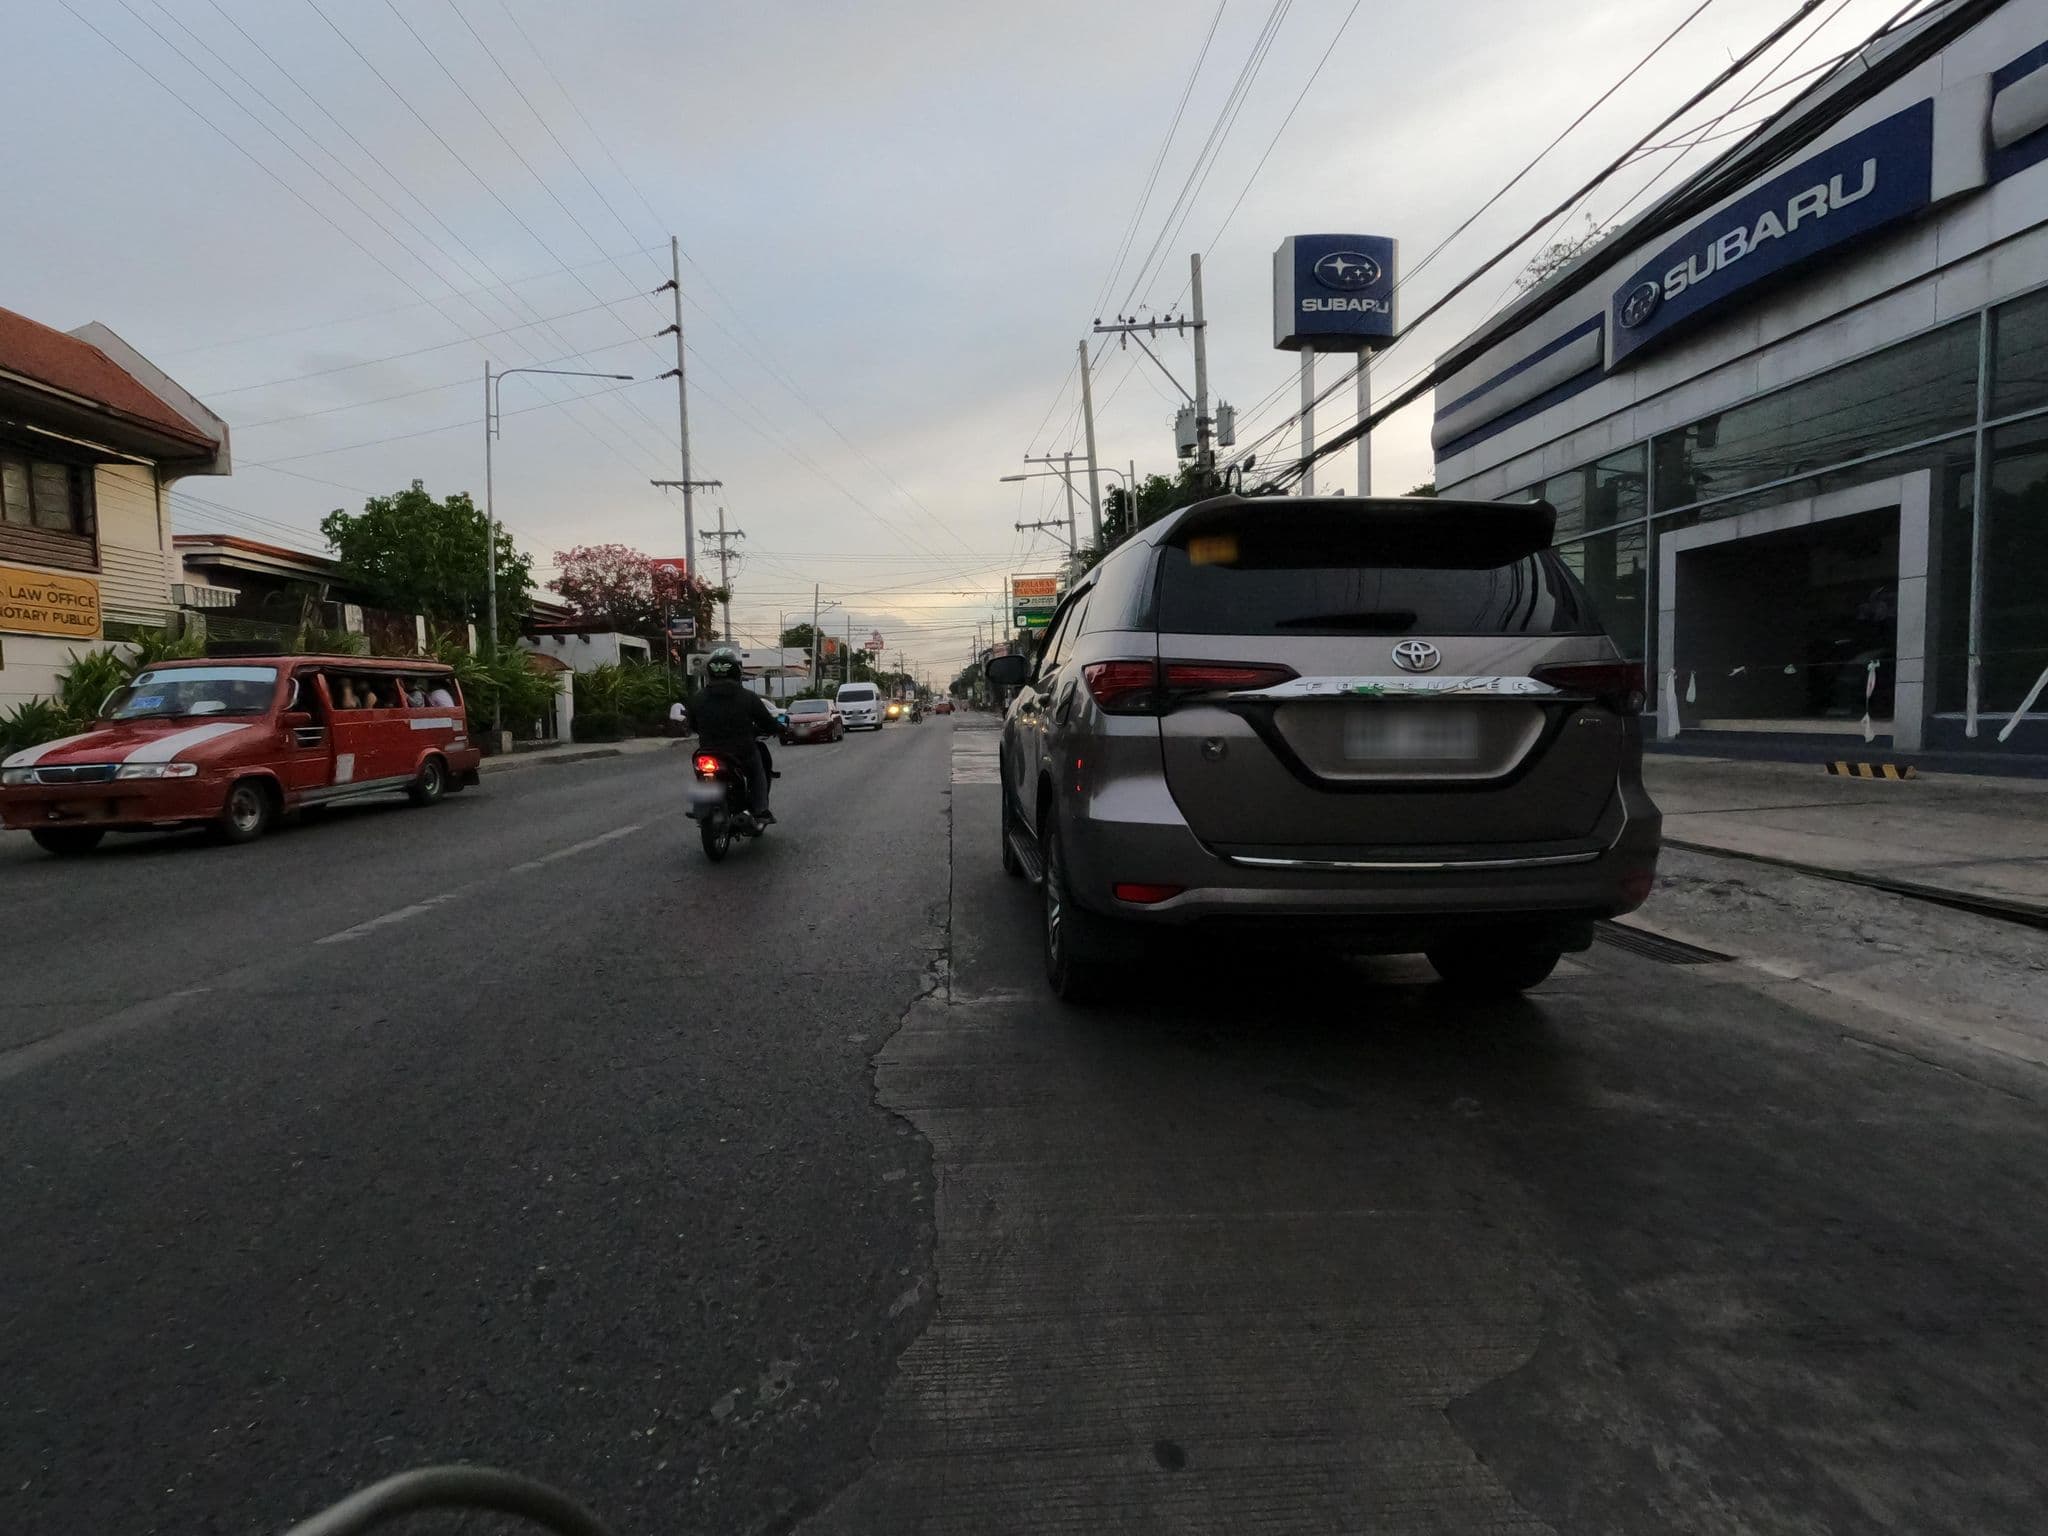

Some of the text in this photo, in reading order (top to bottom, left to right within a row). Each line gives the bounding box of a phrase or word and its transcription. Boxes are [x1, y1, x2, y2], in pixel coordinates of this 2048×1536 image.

[1664, 157, 1878, 301] SUBARU
[1301, 298, 1390, 314] SUBARU
[9, 585, 96, 608] LAW OFFICE
[53, 612, 96, 626] PUBLIC
[1305, 681, 1530, 692] FORTUNER
